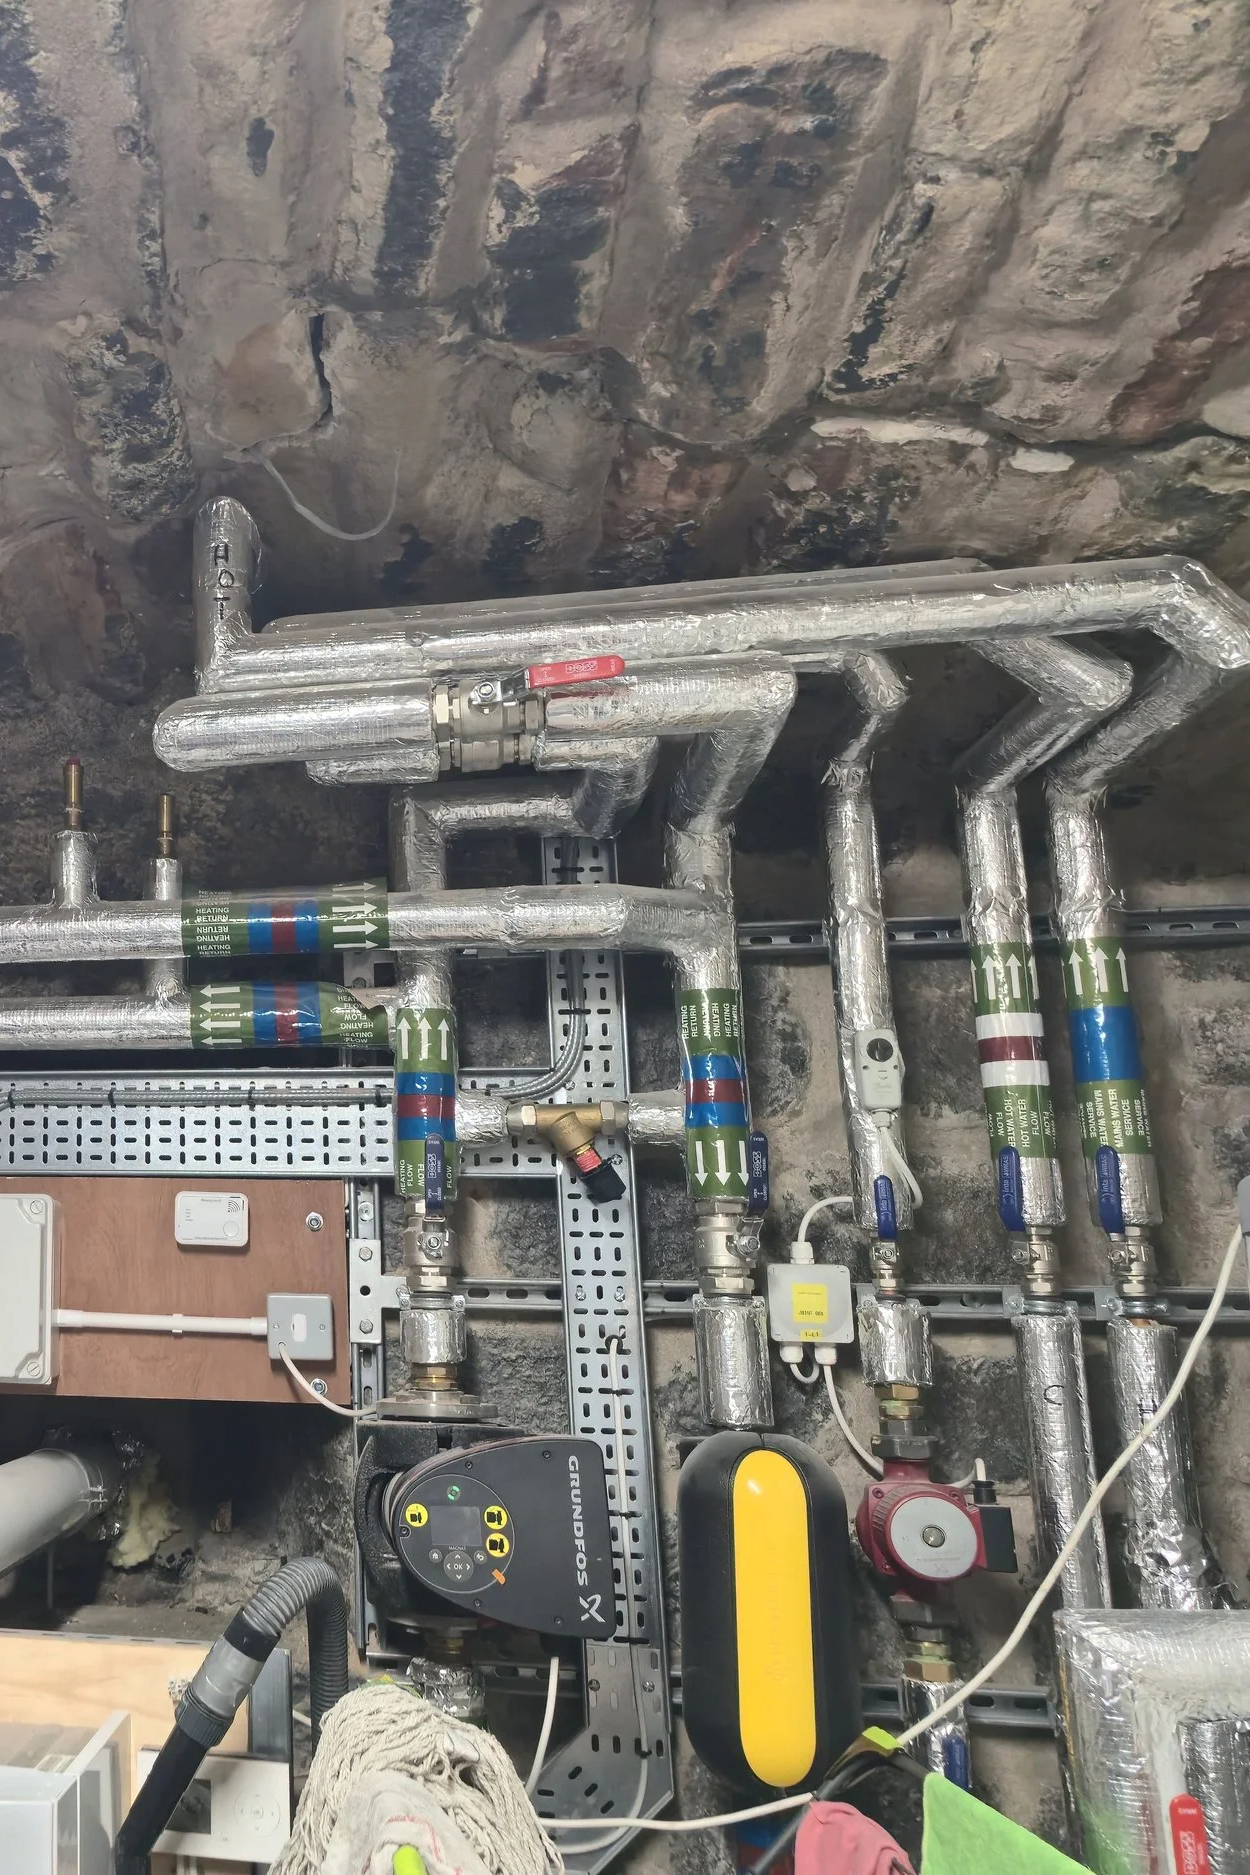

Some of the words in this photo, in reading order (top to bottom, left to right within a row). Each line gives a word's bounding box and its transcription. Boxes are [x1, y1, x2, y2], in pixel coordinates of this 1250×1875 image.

[214, 543, 235, 620] HOT
[565, 660, 598, 674] BOSS
[196, 926, 229, 934] RETURN
[196, 934, 230, 942] HEATING
[340, 1022, 374, 1030] HEATING
[344, 1013, 367, 1021] FLOW
[681, 1005, 689, 1039] HEATING
[690, 1005, 698, 1037] RETURN
[711, 1002, 721, 1037] HEATING
[723, 1003, 732, 1037] HEATING
[1004, 1099, 1014, 1117] HOT
[1017, 1099, 1028, 1128] WATER
[1093, 1089, 1105, 1117] MAINS
[1108, 1088, 1120, 1119] WATER
[1121, 1098, 1134, 1136] SERVICE
[995, 1111, 1005, 1137] FLOW
[1030, 1110, 1040, 1135] FLOW
[1043, 1111, 1052, 1136] FLOW
[1086, 1101, 1097, 1138] SERVICE
[1134, 1099, 1145, 1136] SERVICE
[1020, 1129, 1030, 1148] HOT
[1111, 1119, 1124, 1148] MAINS
[406, 1163, 414, 1187] FLOW
[417, 1164, 425, 1187] FLOW
[427, 1153, 437, 1179] BOSS
[752, 1150, 762, 1178] BOSS
[568, 1455, 589, 1587] GRUNDFOS
